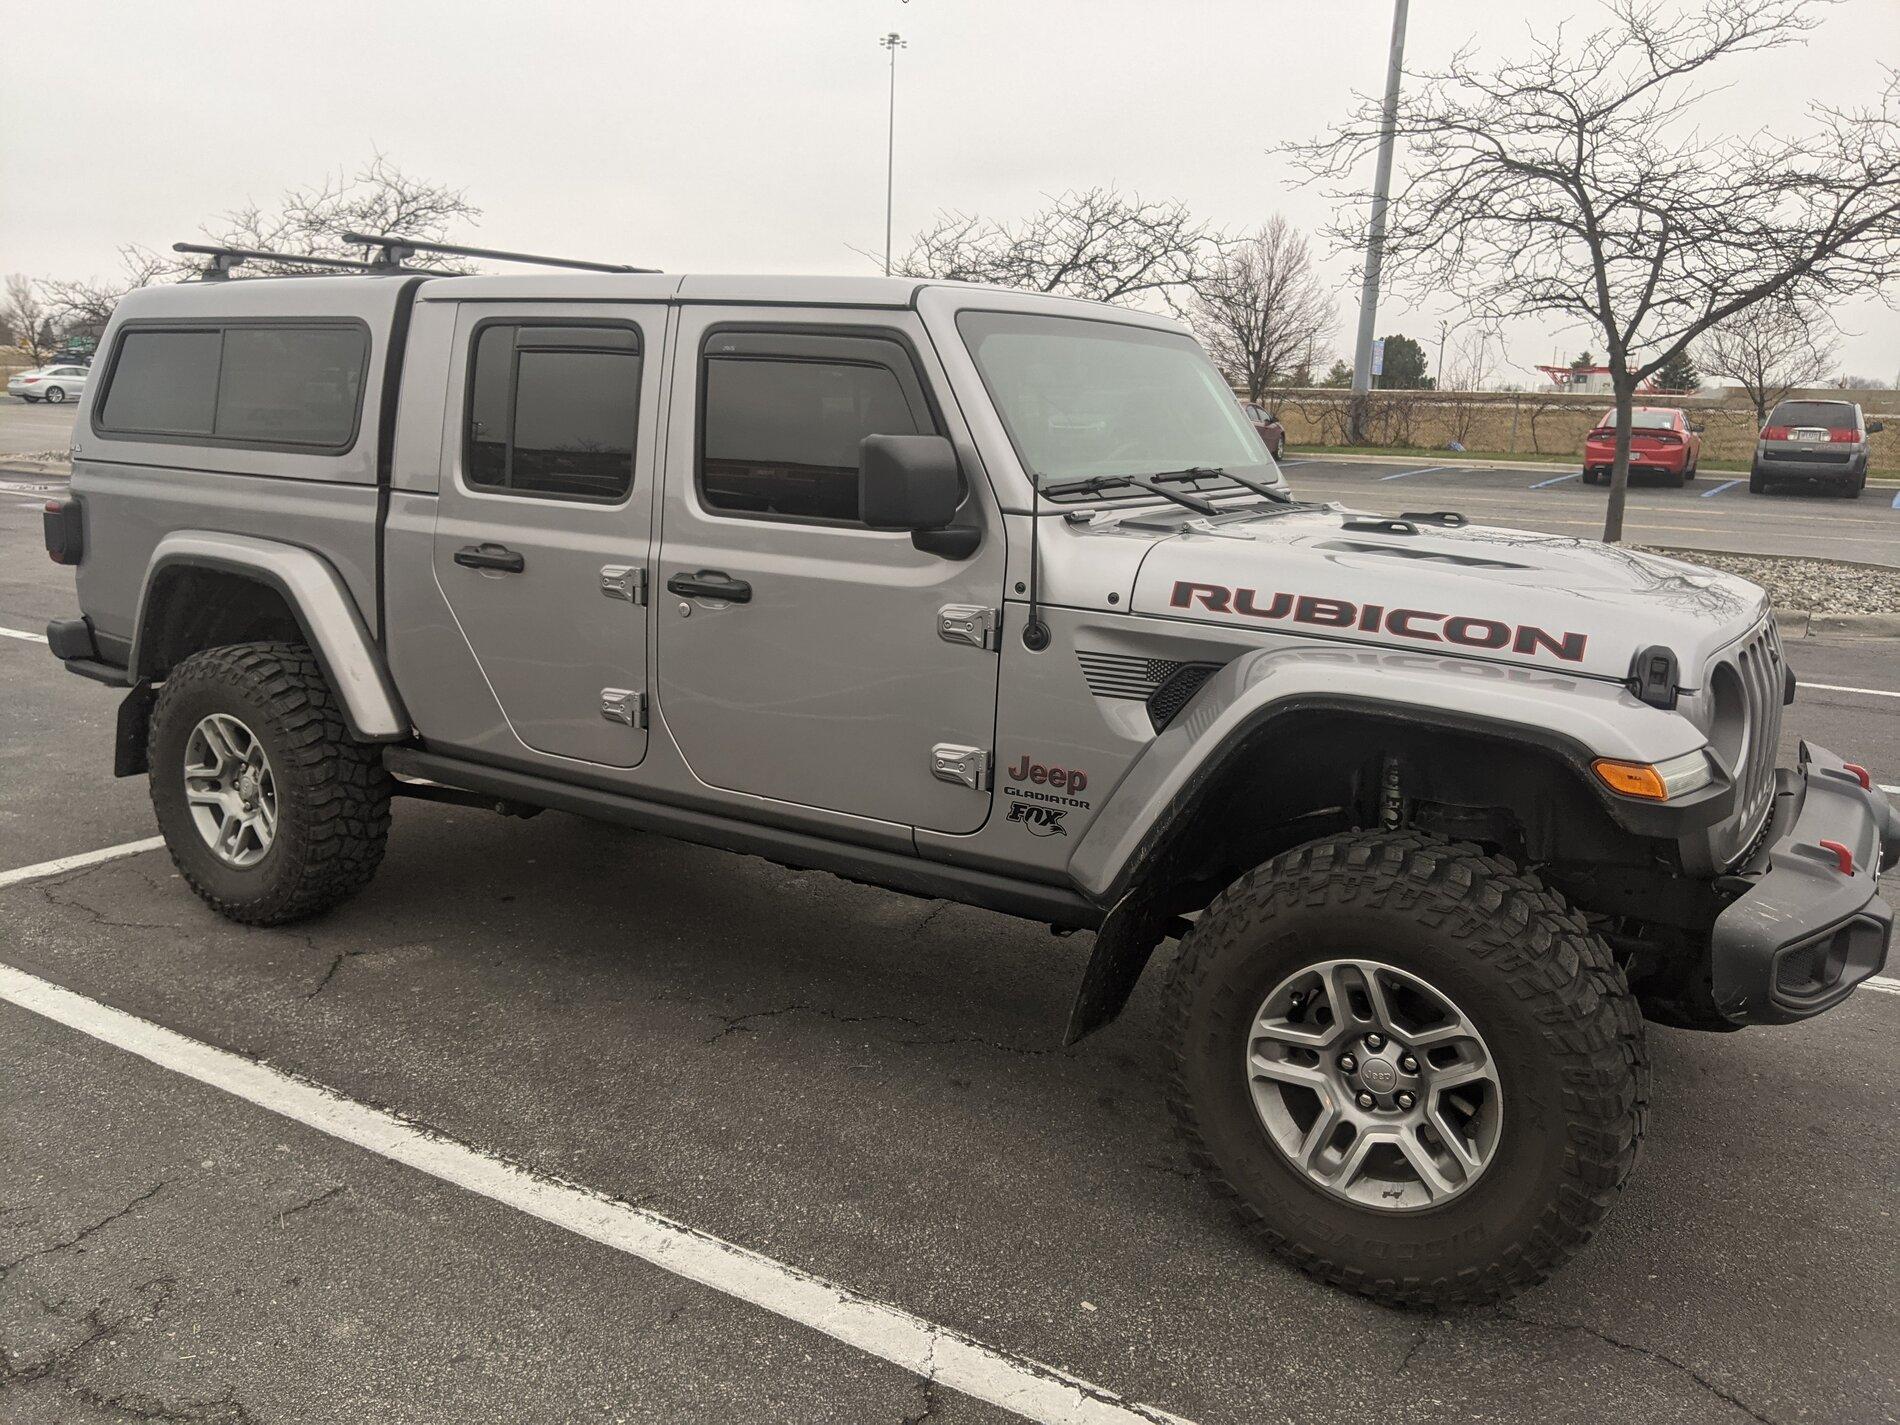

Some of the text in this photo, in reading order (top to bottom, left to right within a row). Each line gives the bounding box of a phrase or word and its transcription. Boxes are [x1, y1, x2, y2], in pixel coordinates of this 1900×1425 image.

[1170, 581, 1587, 662] RUBICON
[1008, 754, 1088, 795] Jeep
[1004, 786, 1090, 809] GLADIATOR
[1006, 801, 1067, 833] FOX
